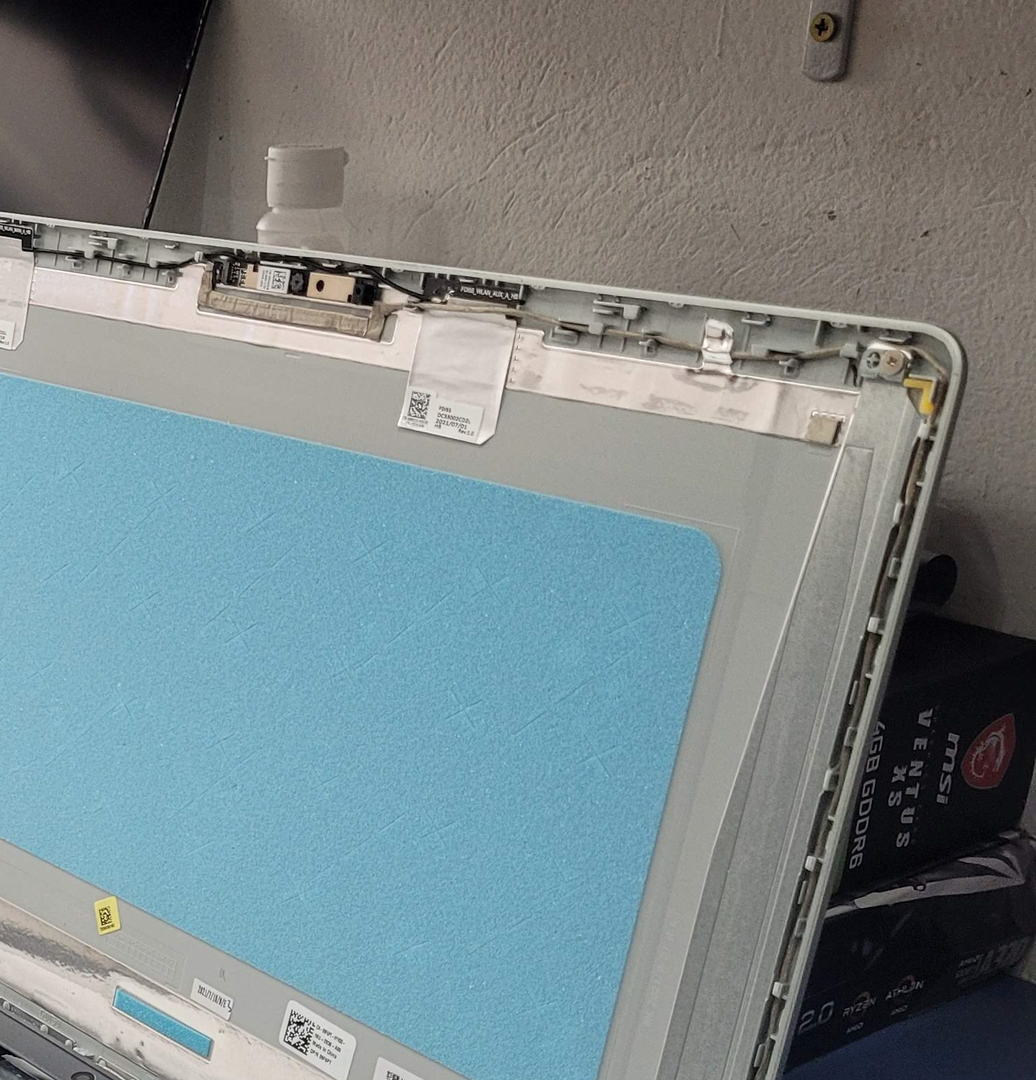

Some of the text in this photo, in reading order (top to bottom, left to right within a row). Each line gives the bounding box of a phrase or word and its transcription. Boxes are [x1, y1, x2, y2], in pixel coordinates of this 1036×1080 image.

[888, 765, 909, 807] XS
[896, 708, 934, 848] VENTUS
[936, 732, 961, 805] msi
[848, 778, 876, 870] GDDR6
[842, 997, 876, 1018] RYZEN
